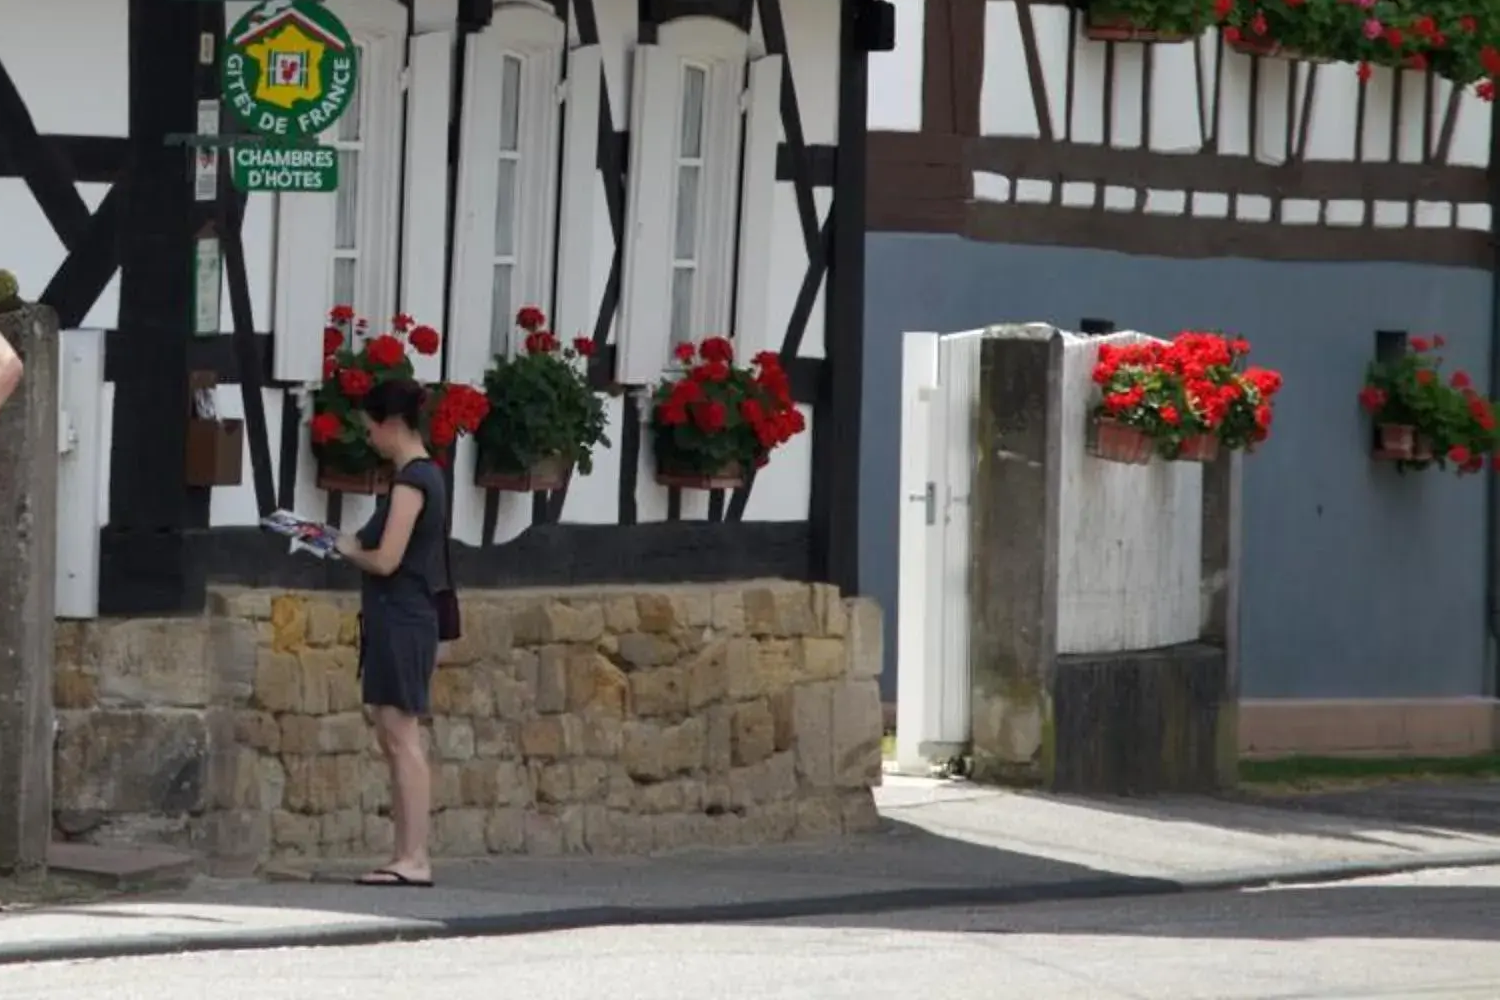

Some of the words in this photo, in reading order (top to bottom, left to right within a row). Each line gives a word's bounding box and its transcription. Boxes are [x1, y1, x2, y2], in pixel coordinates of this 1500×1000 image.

[258, 111, 289, 135] DE
[297, 58, 350, 132] FRANCE
[236, 148, 334, 167] CHAMBRES
[247, 166, 323, 188] D'HÔTES
